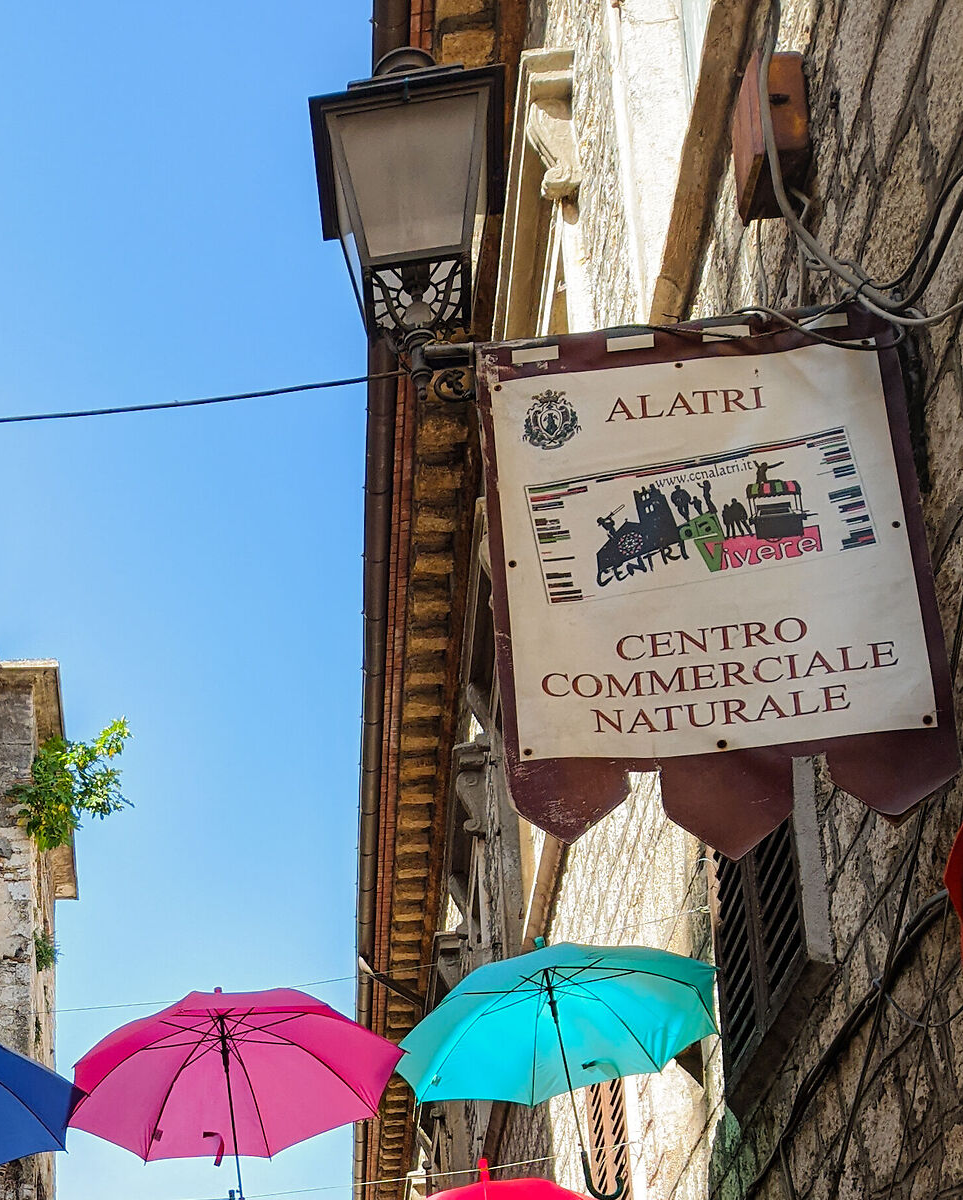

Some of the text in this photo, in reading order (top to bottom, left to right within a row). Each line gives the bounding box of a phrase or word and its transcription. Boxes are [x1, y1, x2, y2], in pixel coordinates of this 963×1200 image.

[604, 386, 768, 423] ALATRI
[654, 460, 754, 489] www.ccnalatri.it
[596, 541, 690, 587] CENTRI
[694, 535, 822, 573] Vivere
[615, 617, 809, 662] CENTRO
[540, 641, 900, 699] COMMERCIALE
[590, 684, 852, 736] NATURALE
